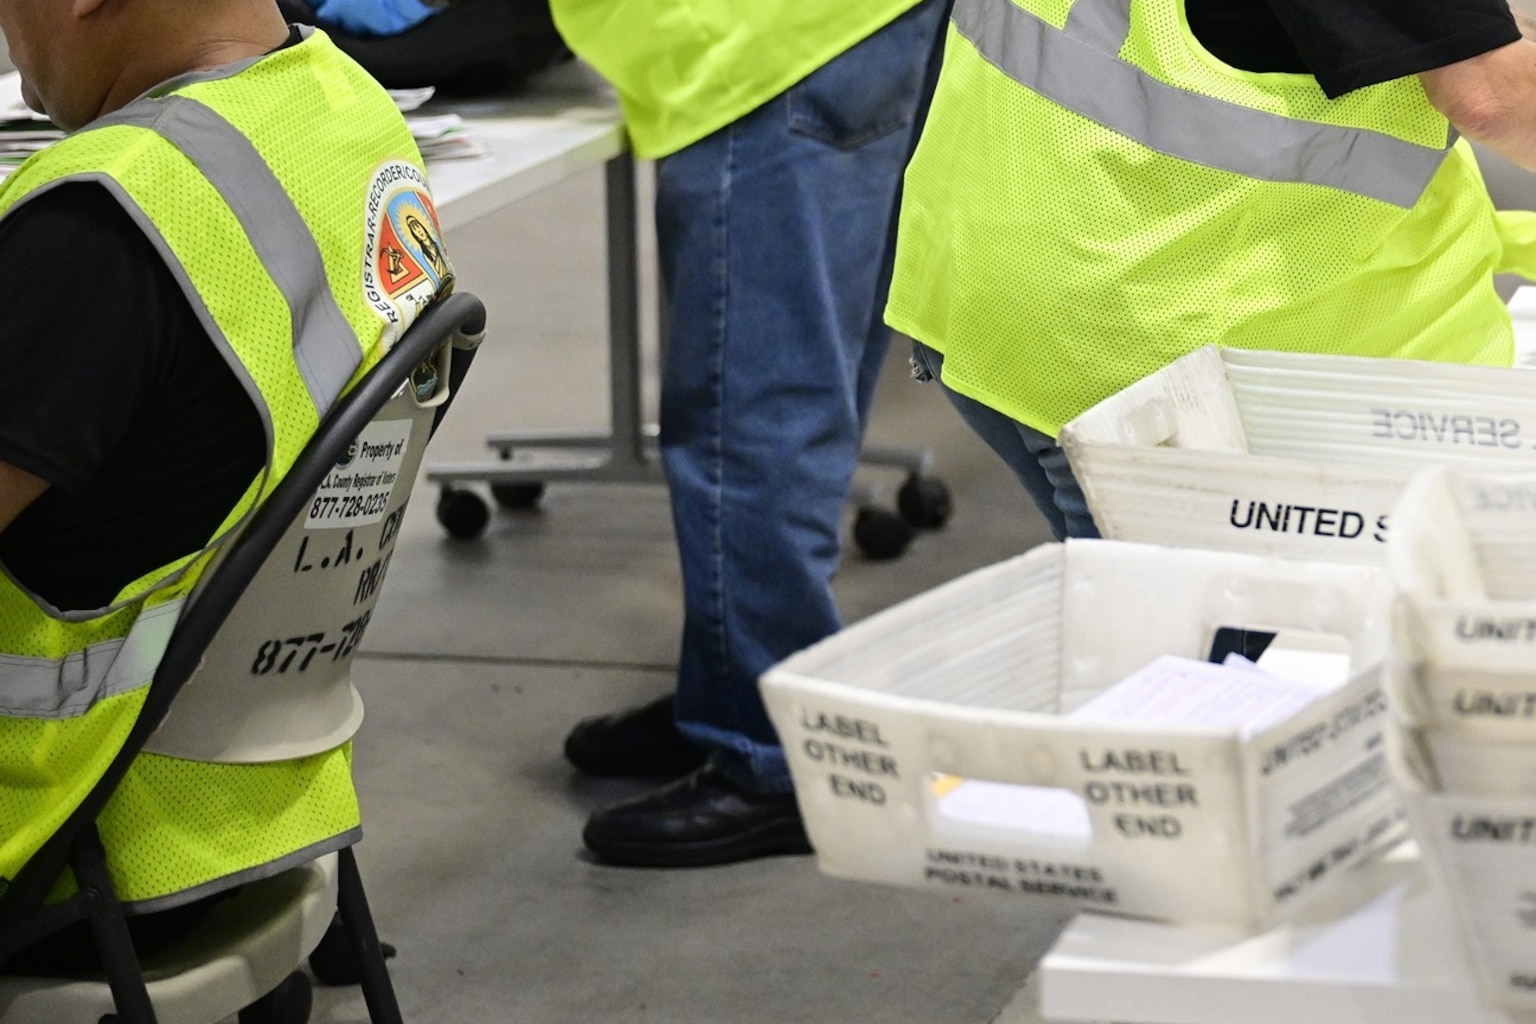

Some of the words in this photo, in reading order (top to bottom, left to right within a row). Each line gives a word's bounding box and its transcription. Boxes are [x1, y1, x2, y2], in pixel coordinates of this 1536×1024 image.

[361, 441, 394, 462] Property
[1230, 499, 1364, 539] UNITED
[294, 528, 364, 573] L.A.
[800, 707, 892, 749] LABEL
[803, 739, 902, 781] OTHER
[1079, 748, 1192, 777] LABEL
[829, 773, 887, 806] END
[1084, 779, 1201, 810] OTHER
[1112, 814, 1183, 840] END
